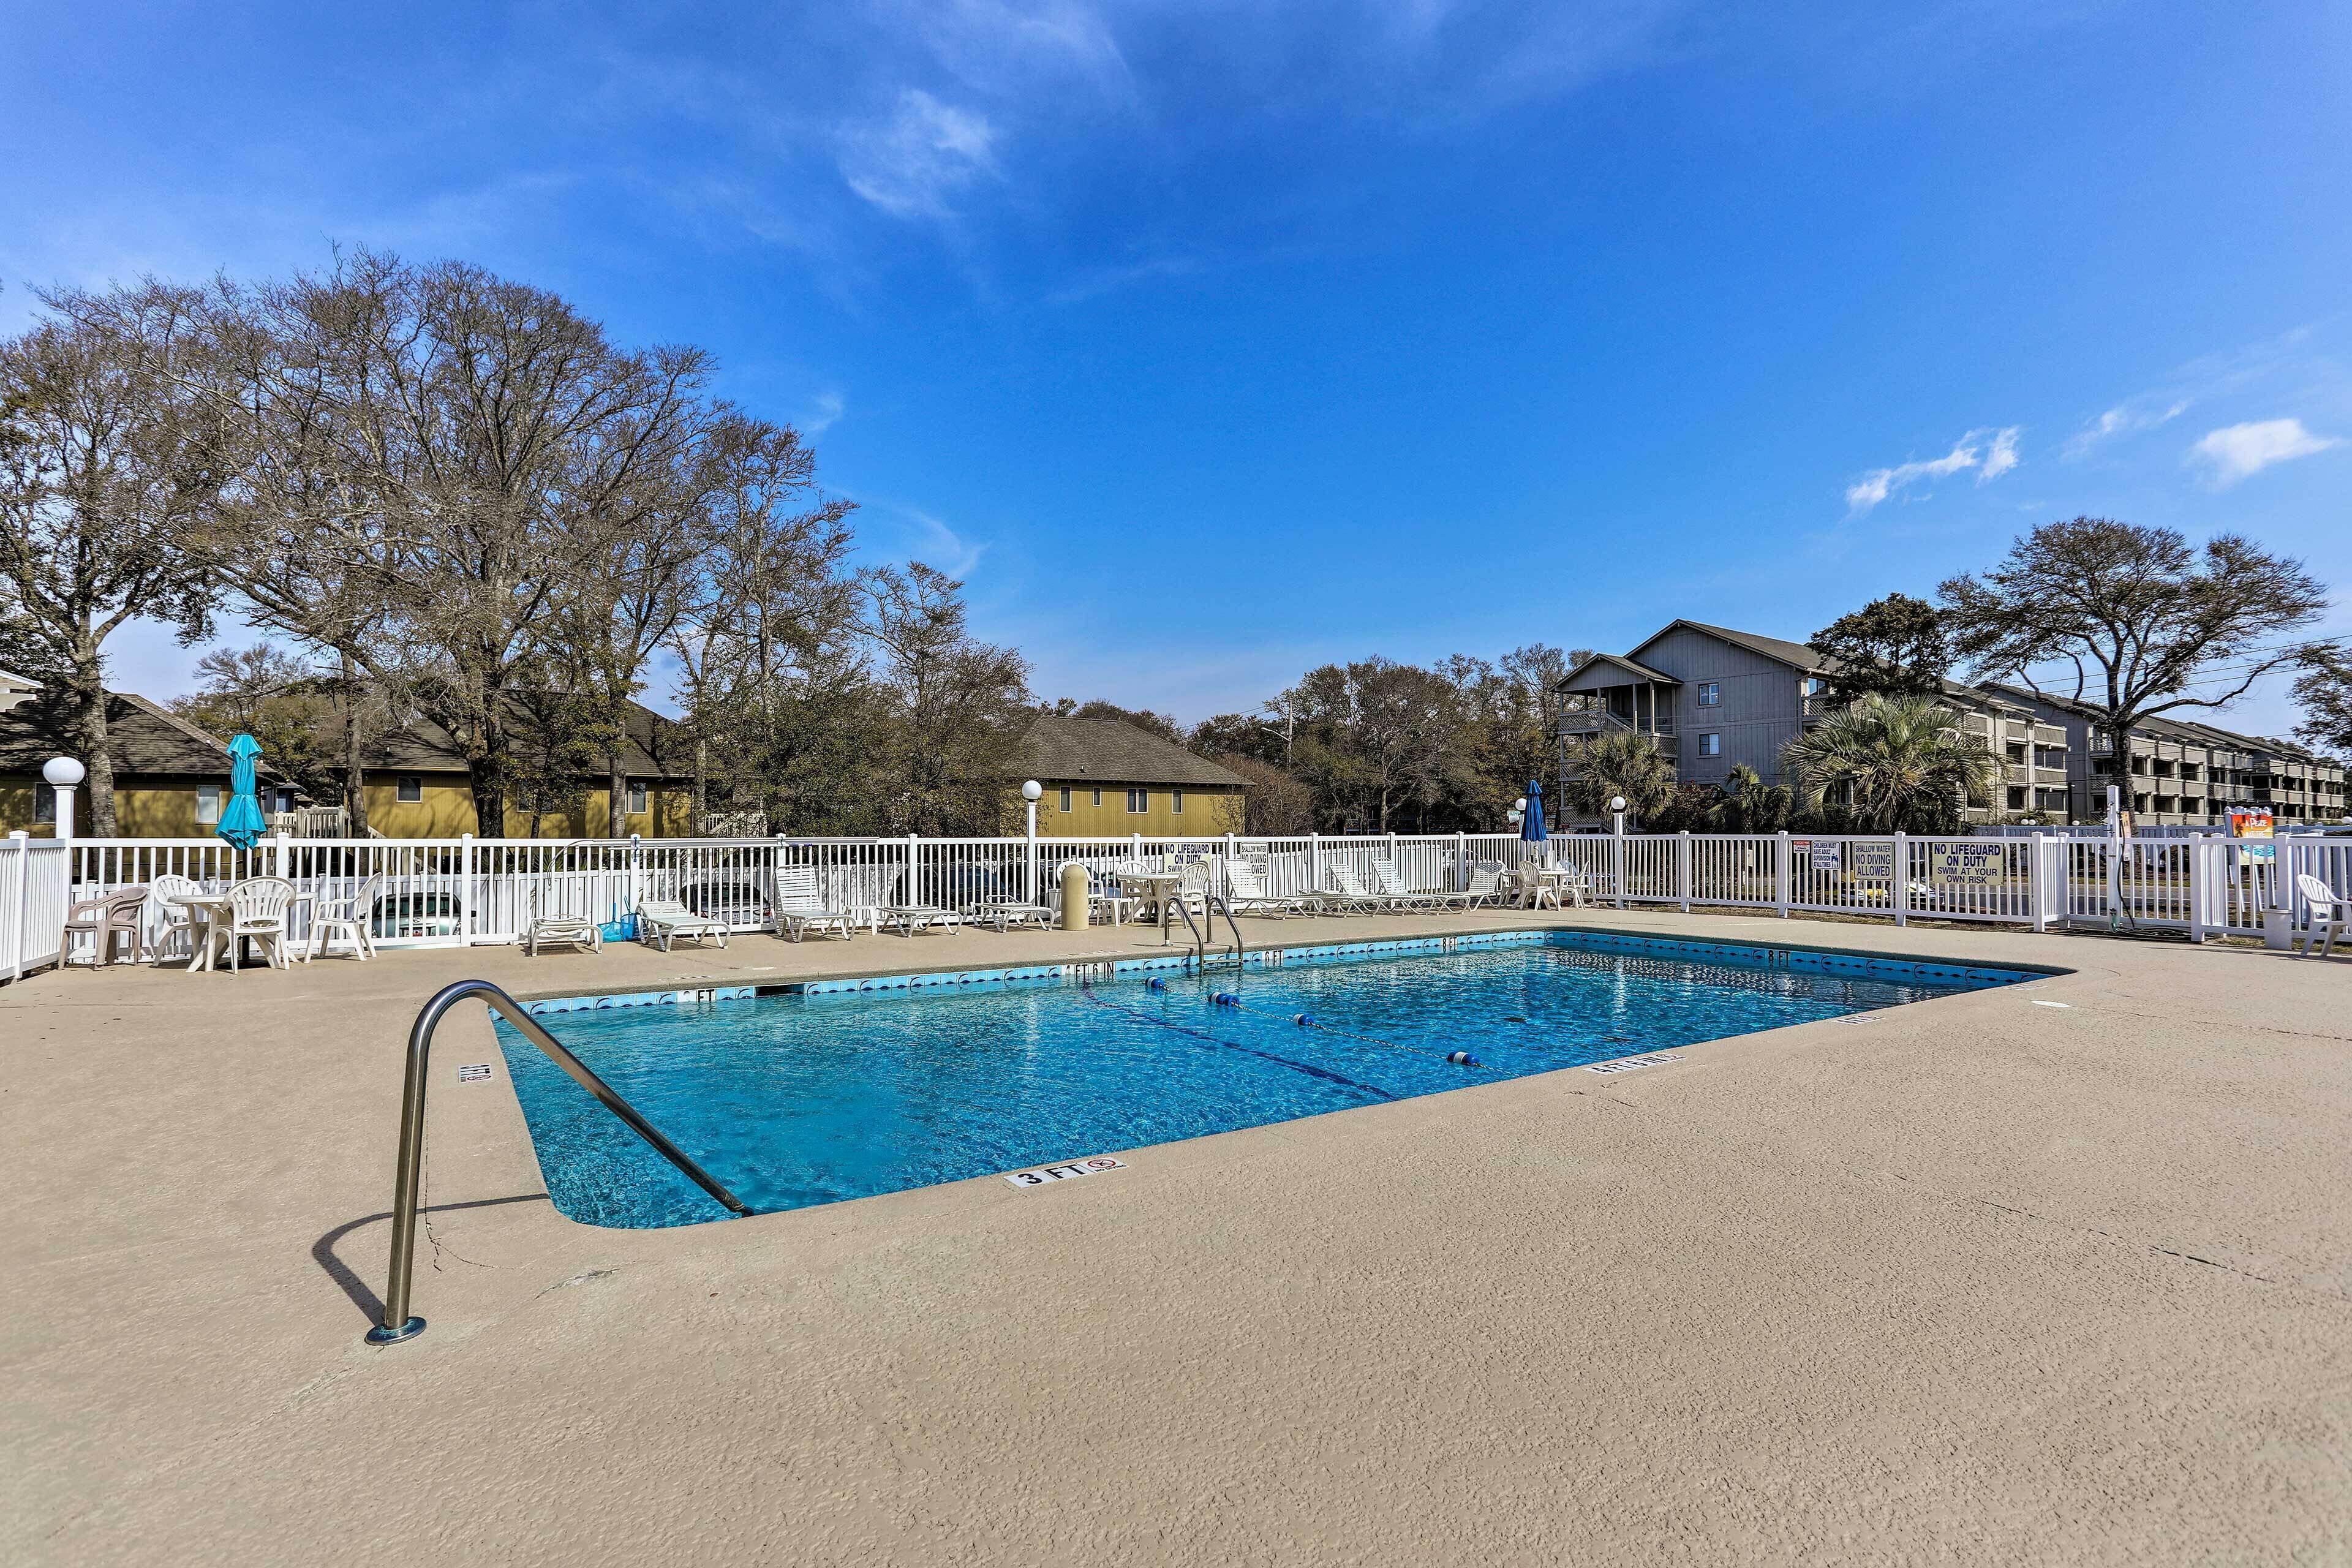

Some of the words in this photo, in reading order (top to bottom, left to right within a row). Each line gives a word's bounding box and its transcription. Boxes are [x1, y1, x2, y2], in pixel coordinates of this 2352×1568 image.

[1166, 844, 1175, 854] NO
[1178, 844, 1209, 854] LIFEGUARD
[1934, 843, 1947, 854] NO
[1950, 844, 2000, 856] LIFEGUARD
[1175, 854, 1183, 864] ON
[1186, 854, 1200, 864] DUTY
[1242, 854, 1249, 862] NO
[1251, 854, 1266, 864] DIVING
[1856, 854, 1865, 864] NO
[1868, 854, 1891, 865] DIVING
[1947, 855, 1959, 866] ON
[1964, 856, 1987, 867] DUTY
[1251, 864, 1267, 874] OWED
[1857, 866, 1890, 876] ALLOWED
[1450, 937, 1457, 948] FT
[1273, 950, 1283, 964] FT
[1768, 950, 1774, 961] 8
[1779, 951, 1790, 965] FT
[1076, 964, 1088, 978] FT
[1093, 963, 1098, 976] 6
[1104, 962, 1114, 979] IN
[698, 989, 714, 1003] FT
[1017, 1173, 1042, 1185] 3
[1044, 1164, 1085, 1179] FT
